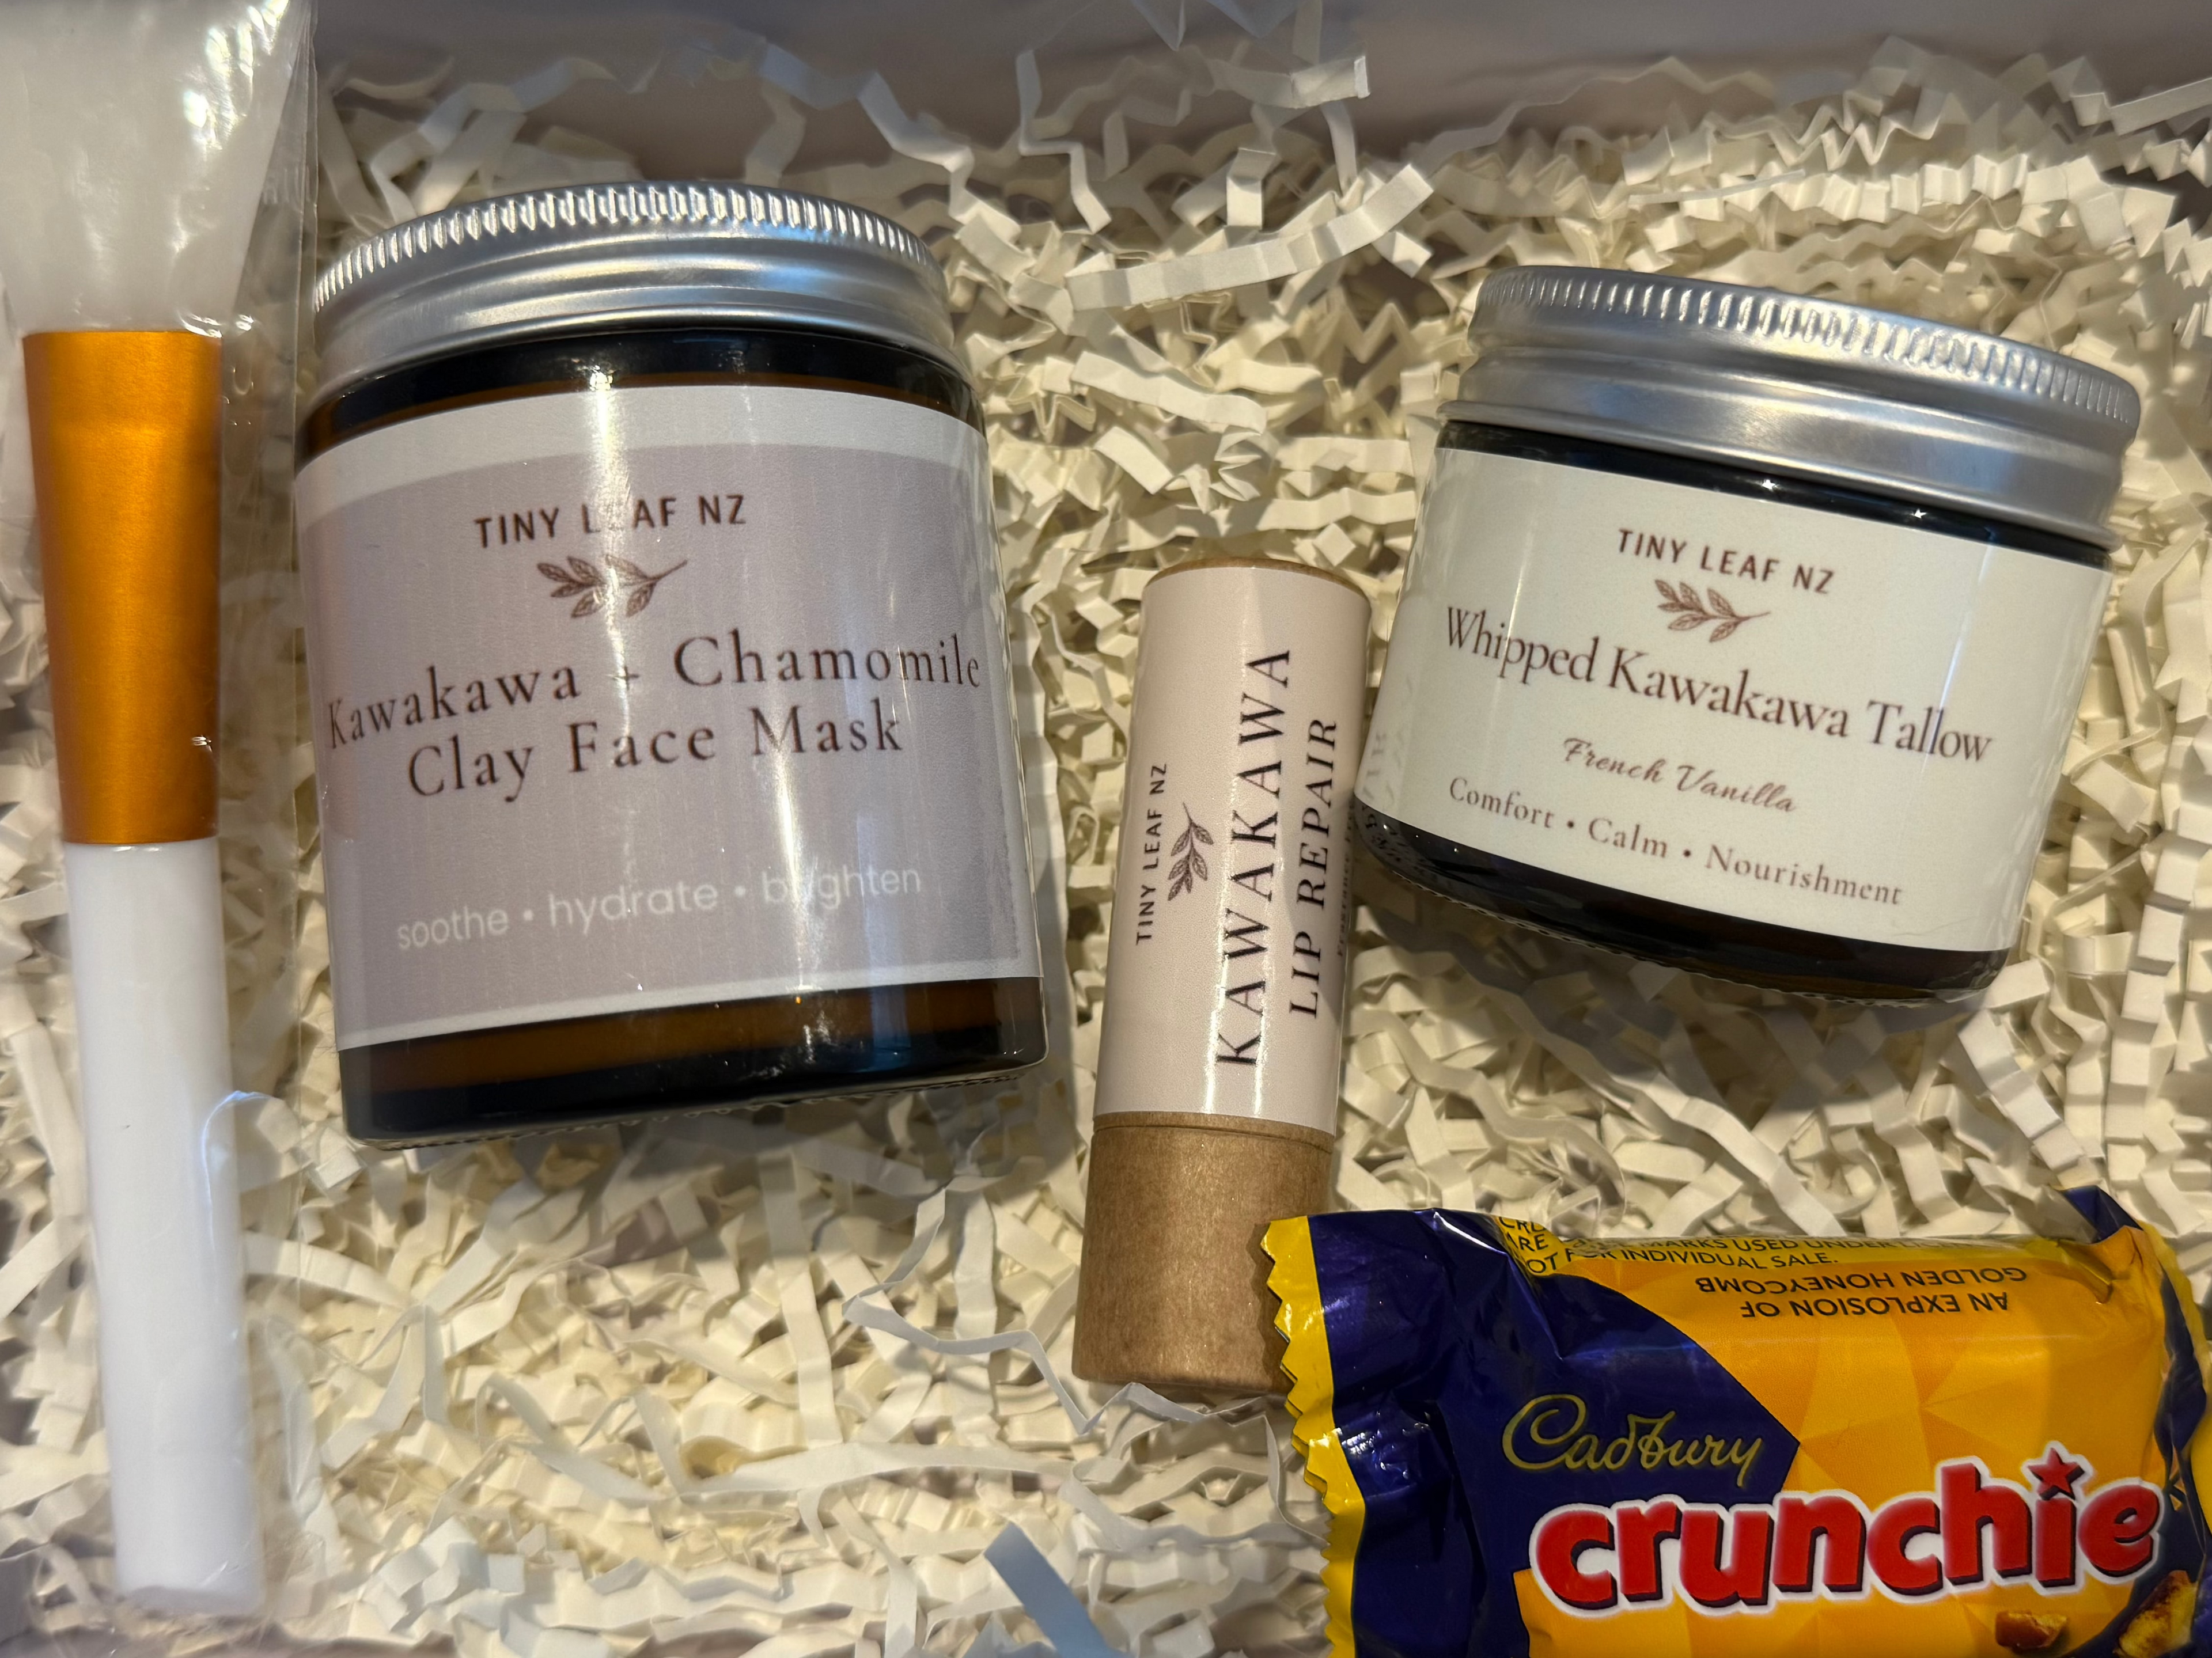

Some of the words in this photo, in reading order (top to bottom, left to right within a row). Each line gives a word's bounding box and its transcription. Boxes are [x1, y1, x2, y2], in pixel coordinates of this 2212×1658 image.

[475, 506, 560, 549] TINY
[581, 496, 677, 533] LAF
[699, 494, 747, 528] NZ
[1617, 528, 1687, 563] TINY
[1700, 545, 1779, 582] LEAF
[1792, 564, 1835, 595] NZ
[327, 665, 582, 749] Kawakawa
[674, 628, 982, 690] Chamomile
[1445, 606, 1599, 685] Whipped
[1609, 646, 1850, 738] Kawakawa
[1866, 700, 1994, 764] Tallow
[408, 738, 534, 803] Clay
[567, 719, 716, 773] Face
[749, 698, 903, 757] Mask
[1150, 763, 1168, 803] NZ
[1562, 737, 1665, 783] French
[1677, 765, 1797, 813] Vanilla
[1142, 807, 1164, 871] LEAF
[1296, 718, 1338, 910] REPAIR
[1449, 776, 1555, 830] Comfort
[1588, 816, 1669, 859] Calm
[1704, 844, 1904, 908] Nourishment
[1215, 650, 1291, 1067] KAWAKAWA
[397, 905, 510, 950] soothe
[550, 873, 719, 934] hydrate
[761, 864, 921, 910] bghten
[1136, 885, 1158, 946] TINY
[1289, 931, 1323, 1019] LIP
[1620, 1249, 1768, 1269] INDIVIDUAL
[1773, 1251, 1839, 1268] SALE.
[1731, 1239, 1799, 1252] USED
[1900, 1266, 2027, 1287] GOLDEN
[1695, 1272, 1895, 1295] HONEYCOMB
[1740, 1299, 1781, 1318] OF
[1788, 1293, 1961, 1316] EXPLOSION
[1967, 1291, 2008, 1311] AN
[1502, 1393, 1766, 1488] Cadbury
[1533, 1448, 2161, 1611] crunchie
